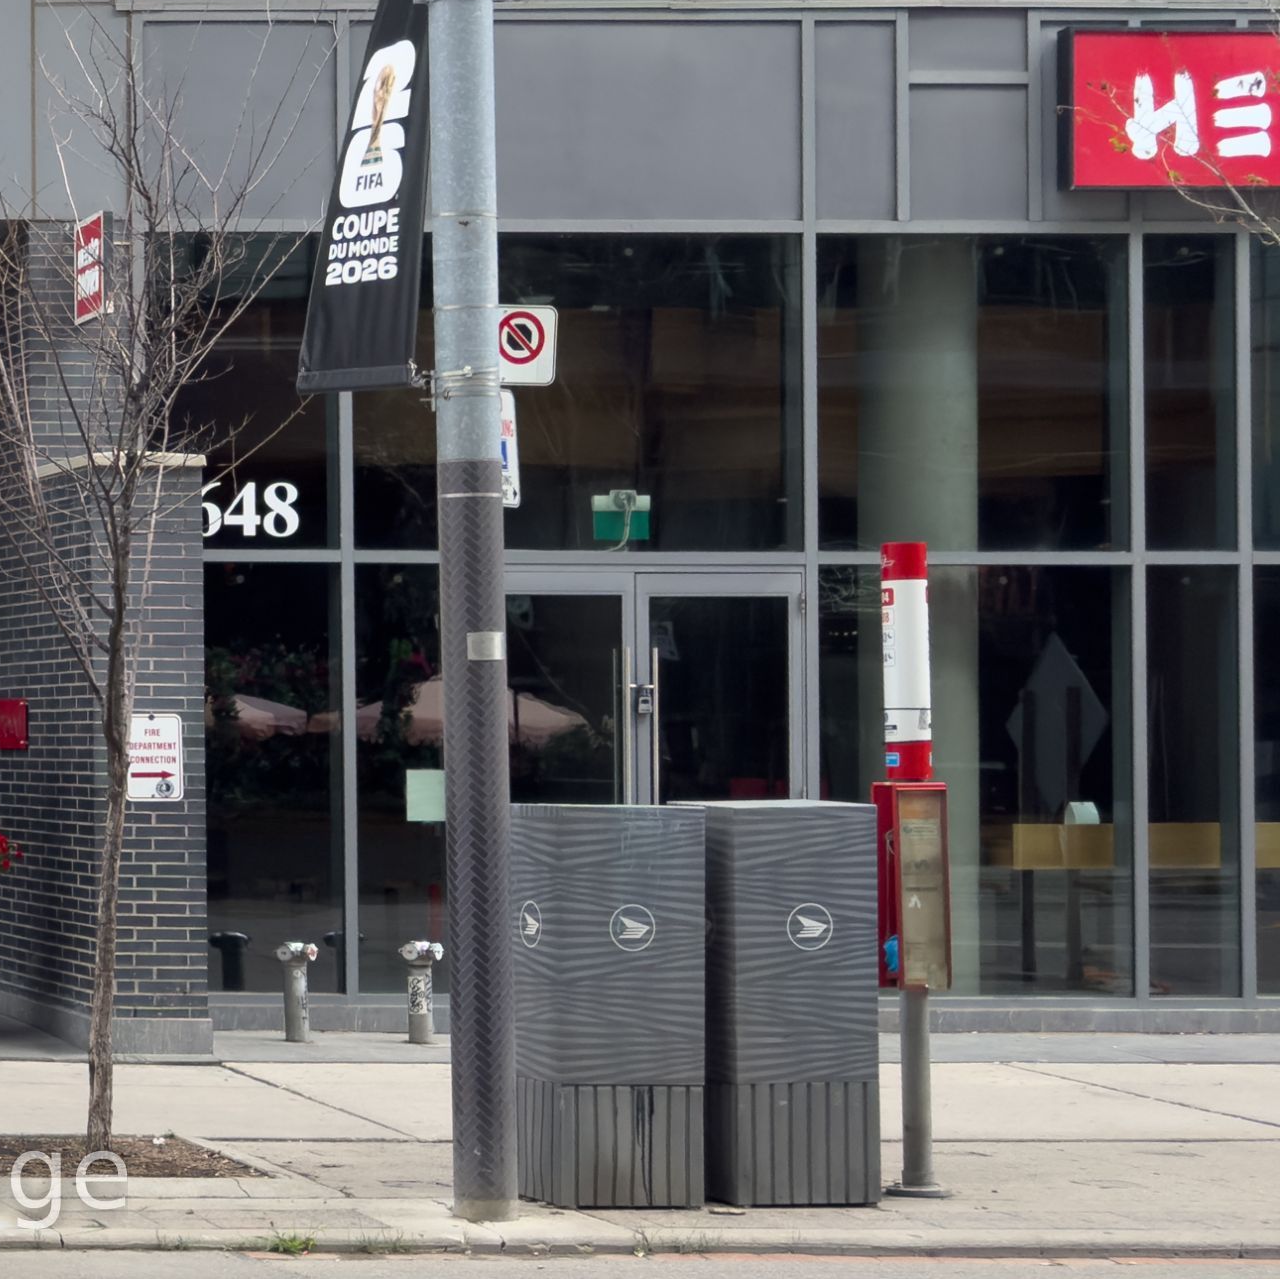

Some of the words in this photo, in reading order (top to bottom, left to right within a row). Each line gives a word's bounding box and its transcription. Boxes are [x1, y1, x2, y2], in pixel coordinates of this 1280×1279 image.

[355, 172, 384, 192] FIFA
[331, 207, 401, 241] COUPE
[328, 242, 349, 261] DU
[349, 235, 400, 257] MONDE
[325, 255, 399, 287] 2026
[144, 728, 160, 737] FIRE
[129, 742, 177, 751] DEPARTMENT
[129, 755, 177, 765] CONNECTION
